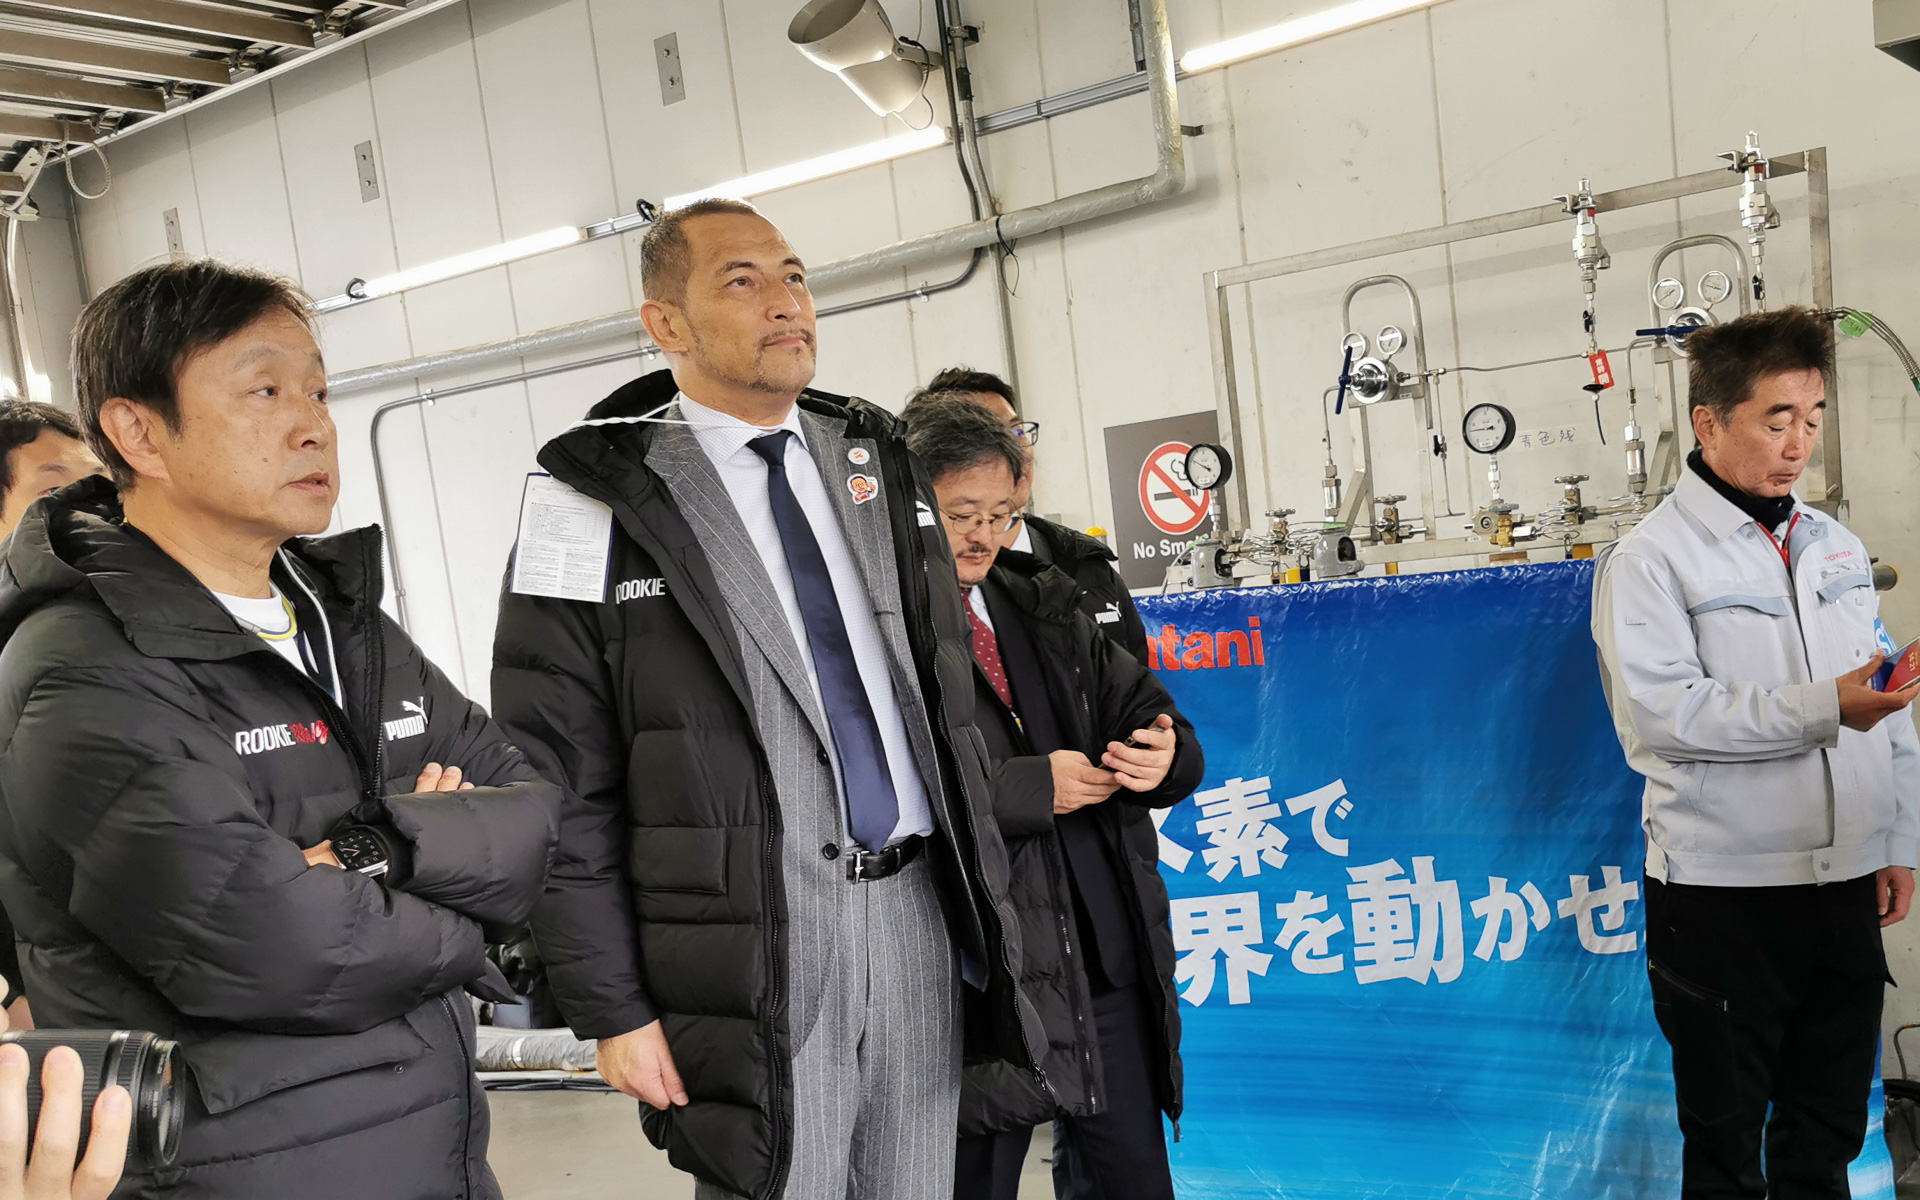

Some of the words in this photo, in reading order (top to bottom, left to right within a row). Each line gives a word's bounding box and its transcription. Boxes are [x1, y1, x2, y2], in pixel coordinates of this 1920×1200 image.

[1132, 541, 1156, 560] No
[235, 723, 296, 755] ROOKIE
[384, 714, 426, 742] PUMA
[1170, 855, 1646, 1009] 界を動かせ
